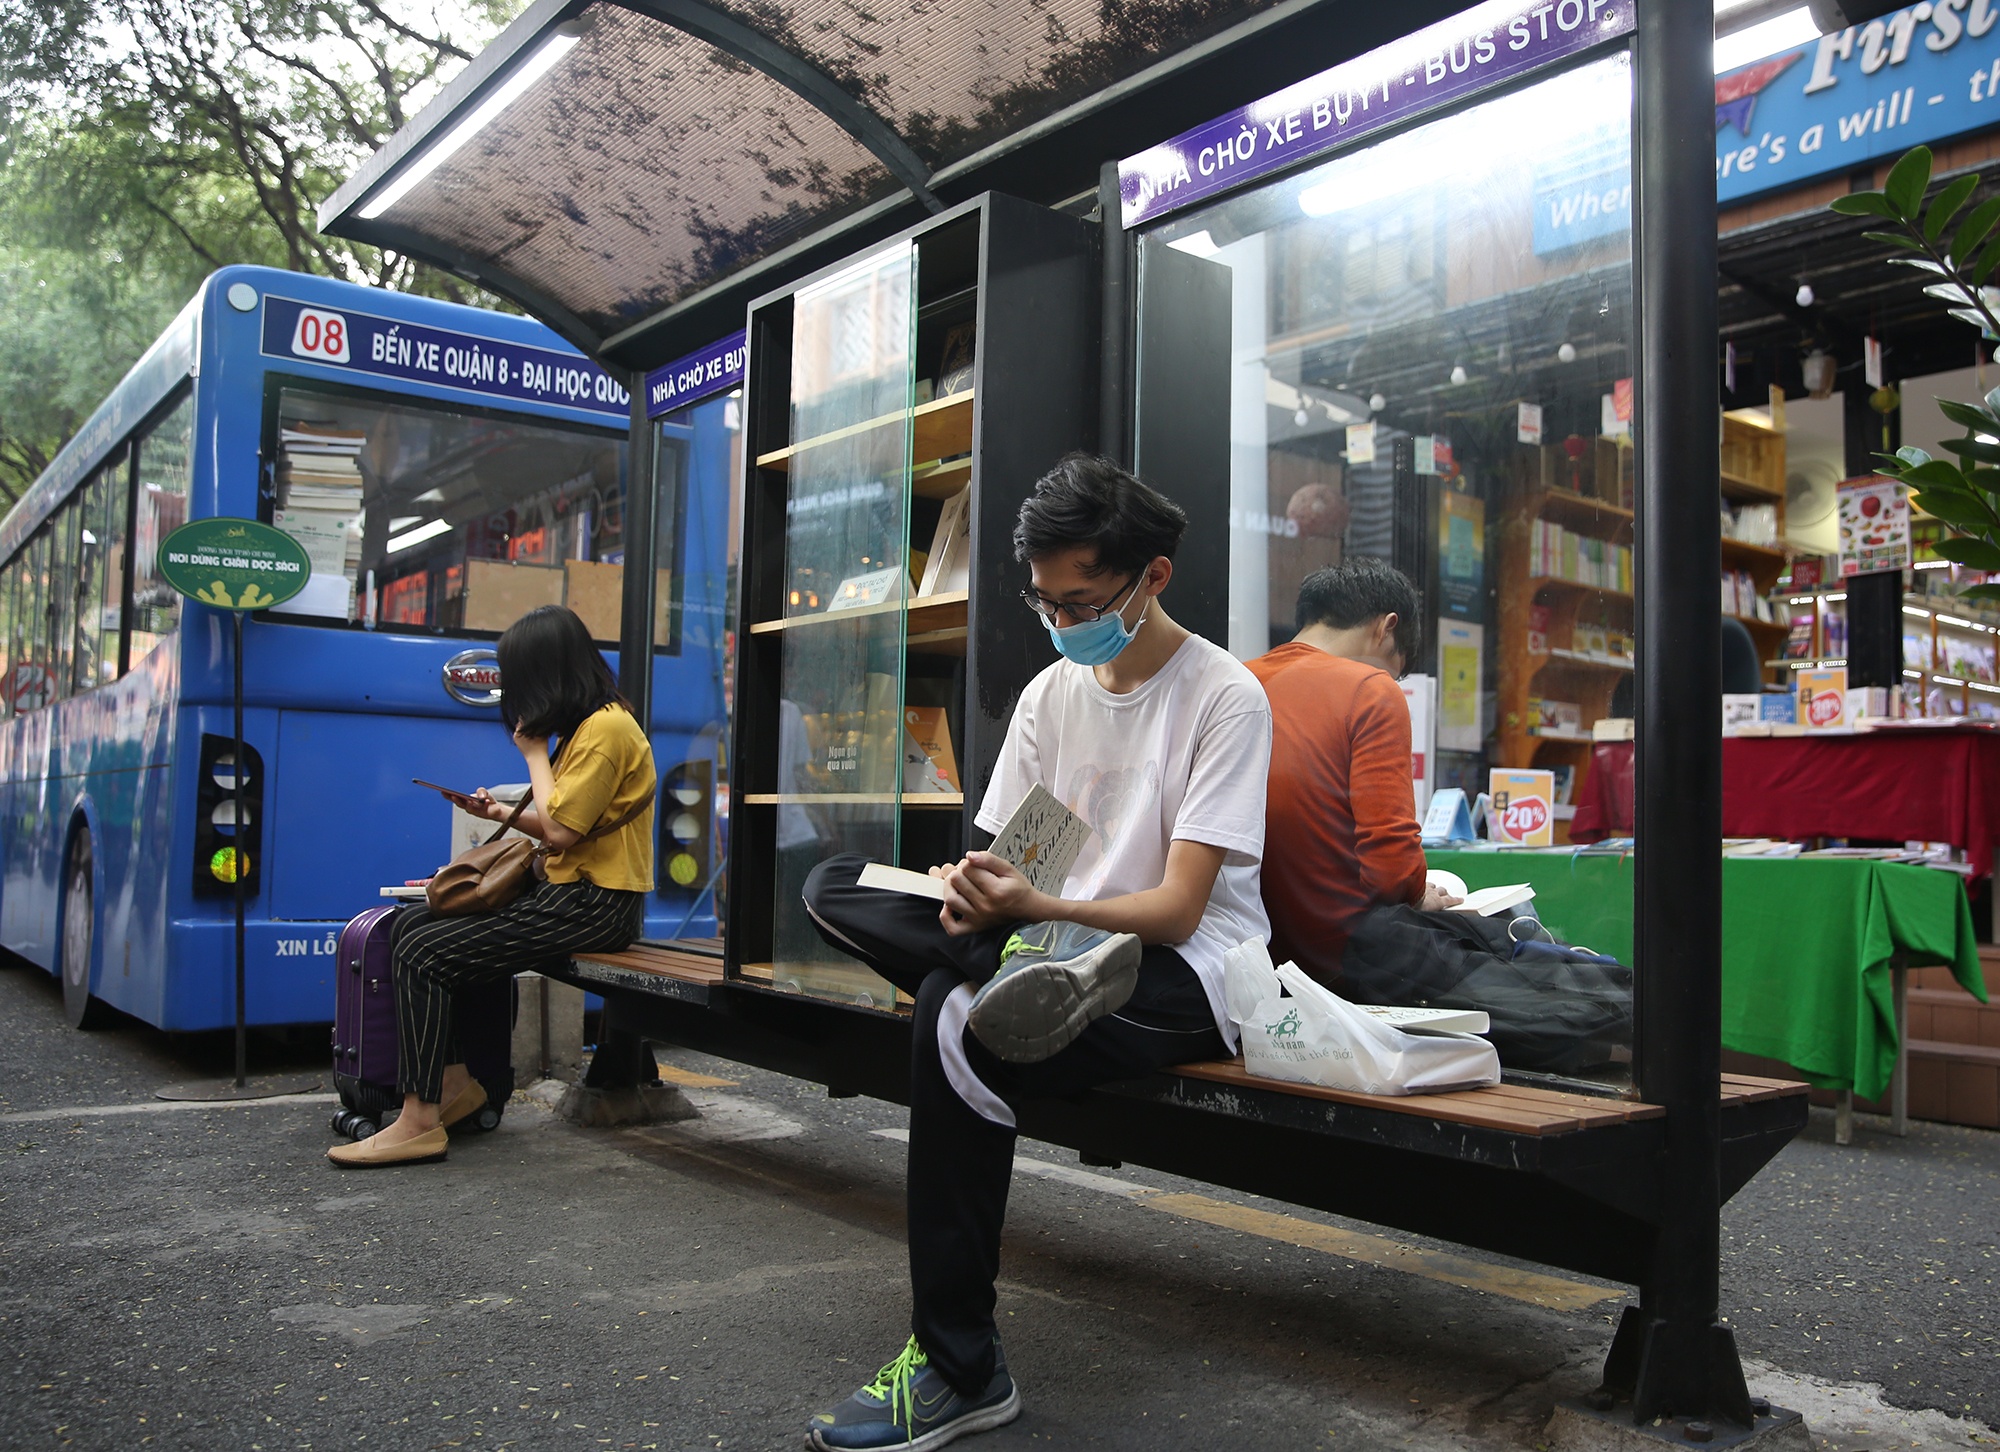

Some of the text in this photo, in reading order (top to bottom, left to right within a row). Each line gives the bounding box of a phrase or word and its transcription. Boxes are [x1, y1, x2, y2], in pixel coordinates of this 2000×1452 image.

[1198, 124, 1258, 177] CHỜ
[1265, 112, 1303, 150] XE
[1424, 30, 1497, 86] BUS
[1507, 0, 1609, 52] STOP
[1798, 123, 1824, 154] a
[1838, 86, 1915, 142] will
[300, 315, 344, 356] 08
[372, 325, 411, 368] BẾN
[416, 340, 440, 373] XE
[444, 344, 495, 386] QUẬN
[498, 361, 509, 385] 8
[511, 372, 520, 380] -
[522, 360, 551, 397] ĐẠI
[555, 368, 591, 402] HỌC
[652, 374, 676, 405] NHÀ
[678, 362, 704, 393] CHỜ
[706, 357, 722, 381] XE
[1505, 806, 1545, 830] 20%
[275, 931, 338, 956] XIN LỖ
[1286, 1041, 1306, 1050] nam
[1309, 1047, 1329, 1060] thế
[1332, 1048, 1354, 1061] giới
